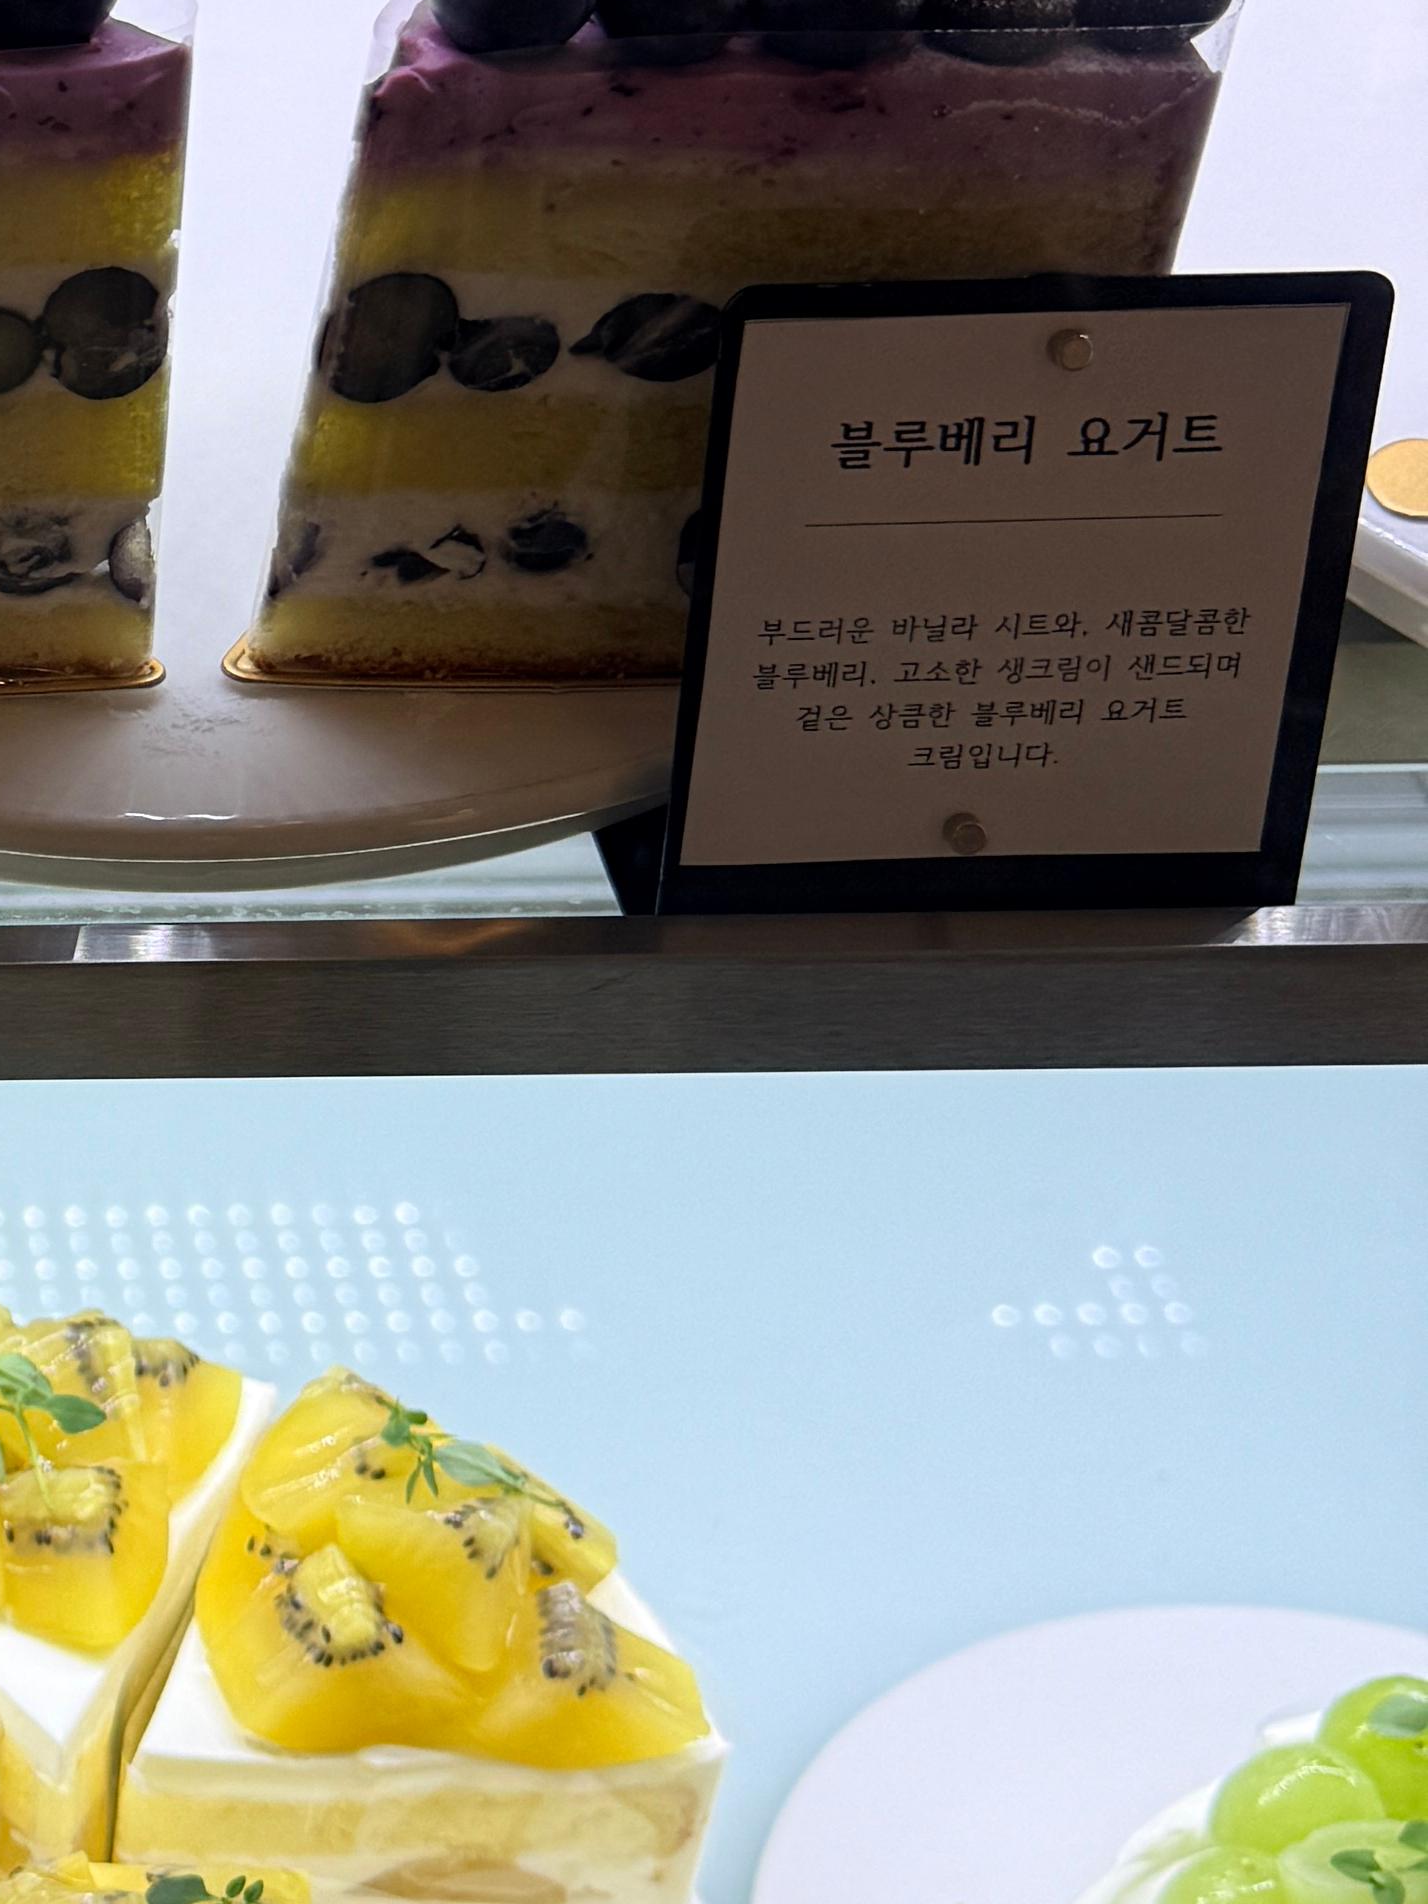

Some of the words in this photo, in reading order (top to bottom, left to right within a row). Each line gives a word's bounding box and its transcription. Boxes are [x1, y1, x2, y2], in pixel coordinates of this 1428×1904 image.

[830, 414, 1036, 470] 블루베리
[1066, 411, 1223, 462] 요거트
[757, 616, 875, 647] 부드러운
[892, 613, 979, 643] 바닐라
[1105, 606, 1252, 637] 새콤달콤한
[893, 657, 983, 686] 고소한
[997, 654, 1112, 685] 생크림이
[1128, 651, 1242, 681] 샌드되며
[796, 704, 854, 732] 겉은
[868, 701, 956, 731] 상큼한
[971, 698, 1085, 728] 블루베리
[1100, 696, 1187, 724] 요거트
[907, 741, 1058, 770] 크림입니다.
